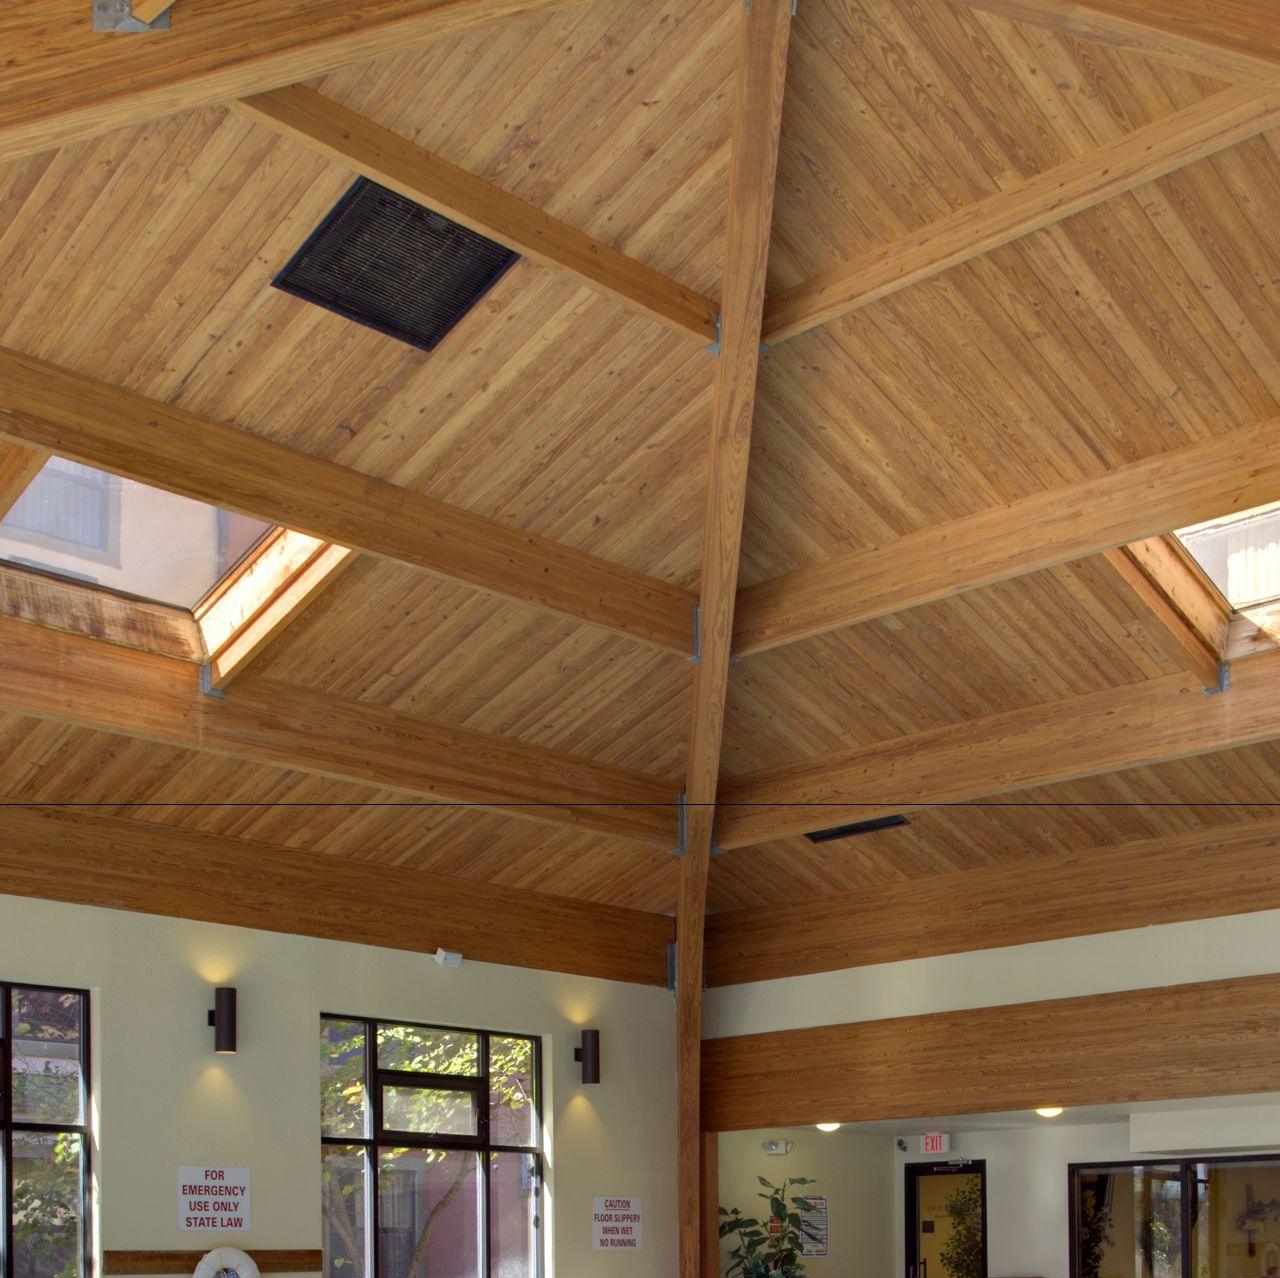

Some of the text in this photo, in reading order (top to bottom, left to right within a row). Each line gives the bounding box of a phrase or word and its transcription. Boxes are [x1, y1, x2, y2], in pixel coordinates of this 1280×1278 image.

[925, 1135, 943, 1152] EXIT
[204, 1170, 224, 1180] FOR
[182, 1185, 246, 1196] EMERGENCY
[189, 1201, 239, 1212] USE ONLY
[605, 1199, 631, 1208] CAUTION
[185, 1217, 243, 1228] STATE LAW
[594, 1214, 641, 1223] FLOOR SLIPPERY
[602, 1226, 633, 1235] WHEN WET
[600, 1238, 637, 1247] NO RUNNING
